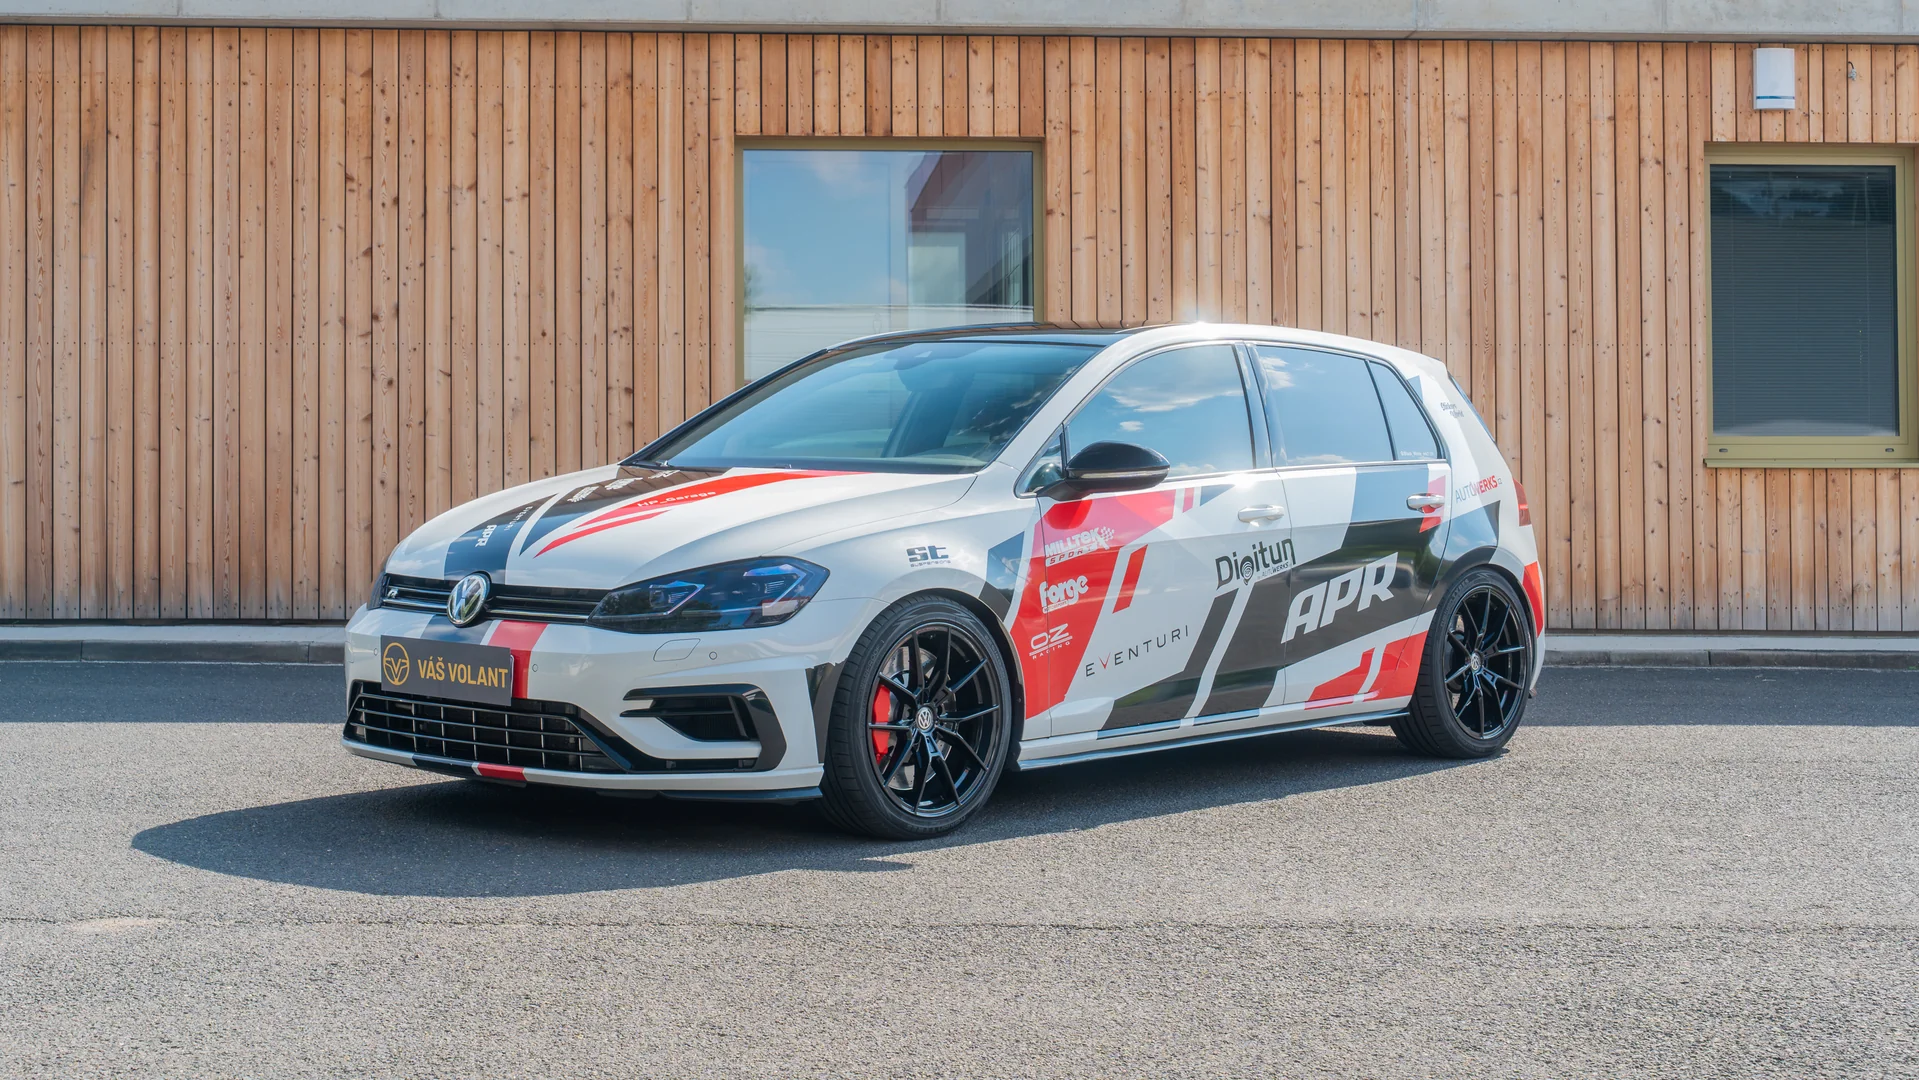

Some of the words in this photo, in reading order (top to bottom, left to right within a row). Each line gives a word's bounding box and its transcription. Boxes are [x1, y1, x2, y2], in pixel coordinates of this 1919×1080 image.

[475, 525, 498, 547] APR
[1045, 527, 1110, 557] MILLTEK
[1039, 575, 1089, 608] forge
[1281, 551, 1399, 644] APR
[1085, 625, 1189, 677] EVENTURI
[417, 656, 445, 682] VÁŠ
[448, 662, 509, 689] VOLANT
